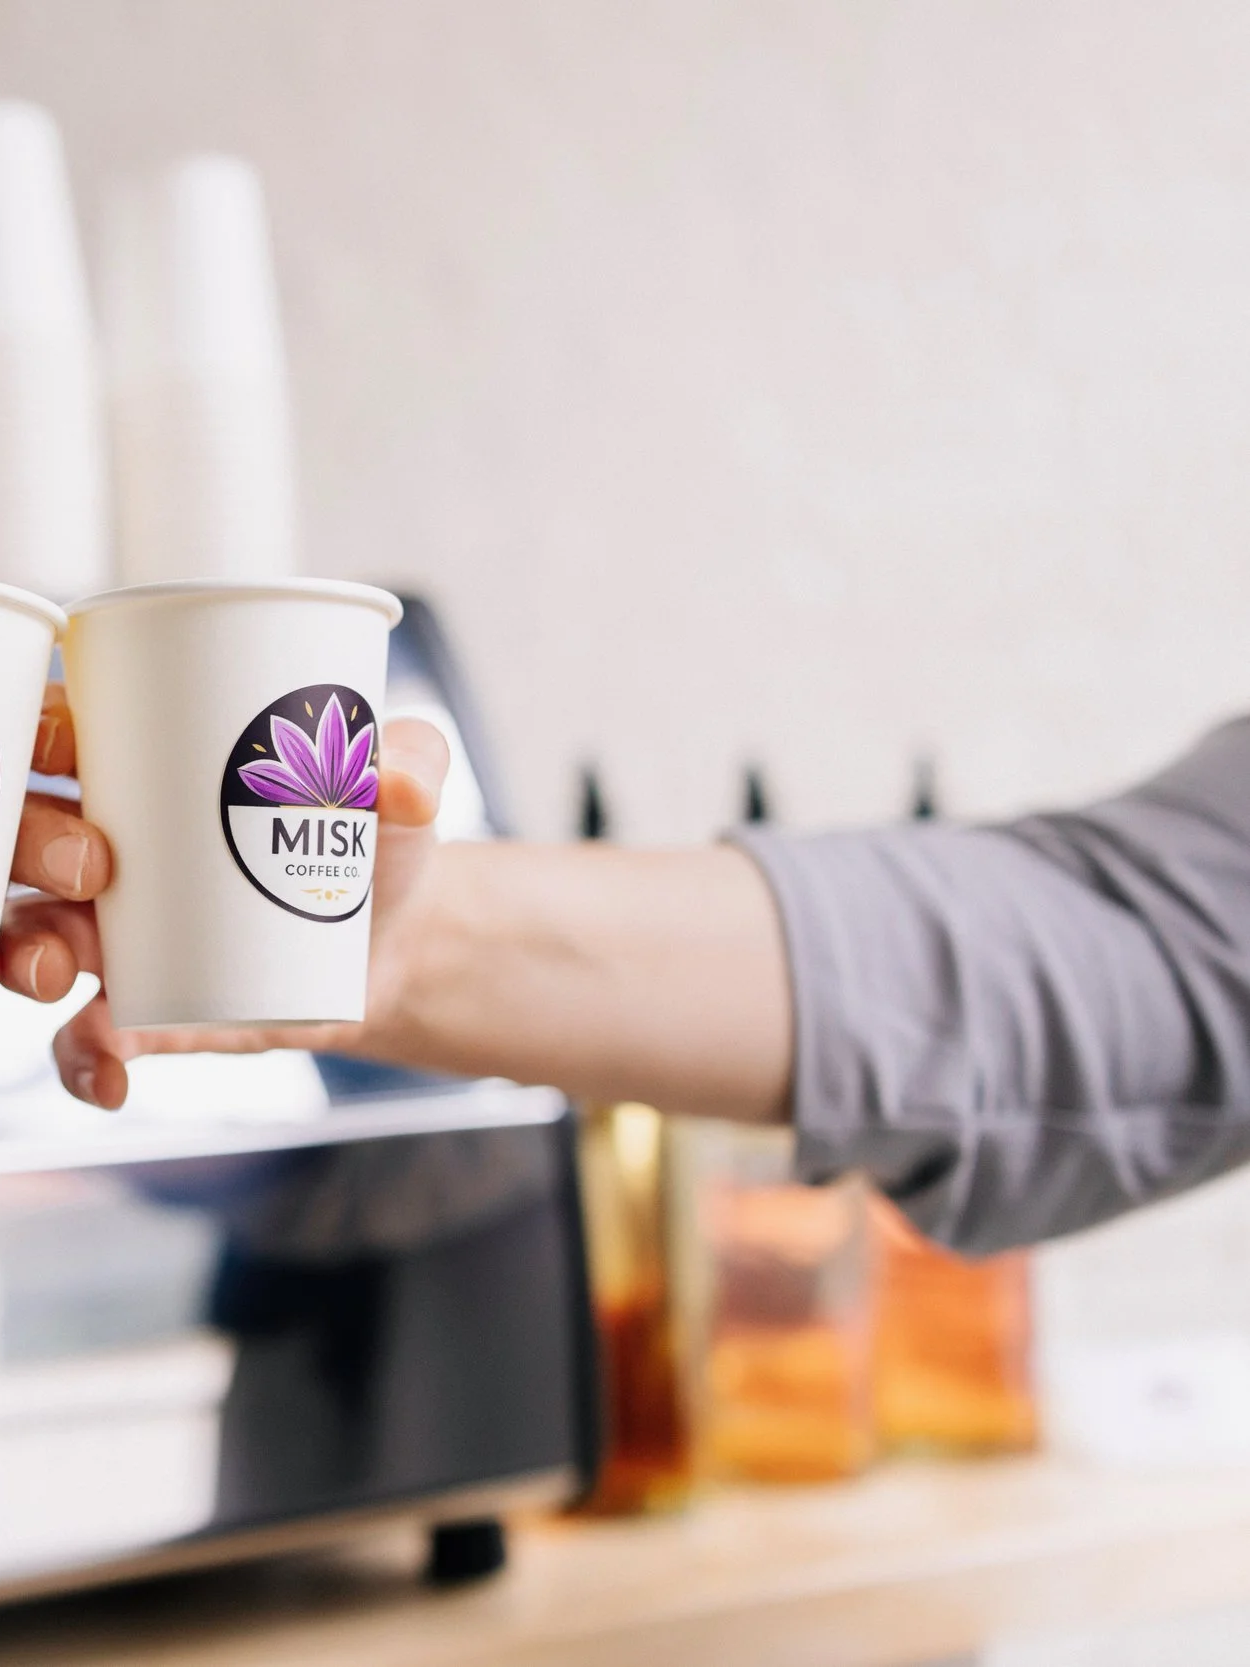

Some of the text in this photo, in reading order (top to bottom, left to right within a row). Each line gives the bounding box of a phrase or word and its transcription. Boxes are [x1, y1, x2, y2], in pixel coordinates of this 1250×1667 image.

[271, 817, 367, 857] MISK
[285, 864, 361, 878] COFFEE CO.
